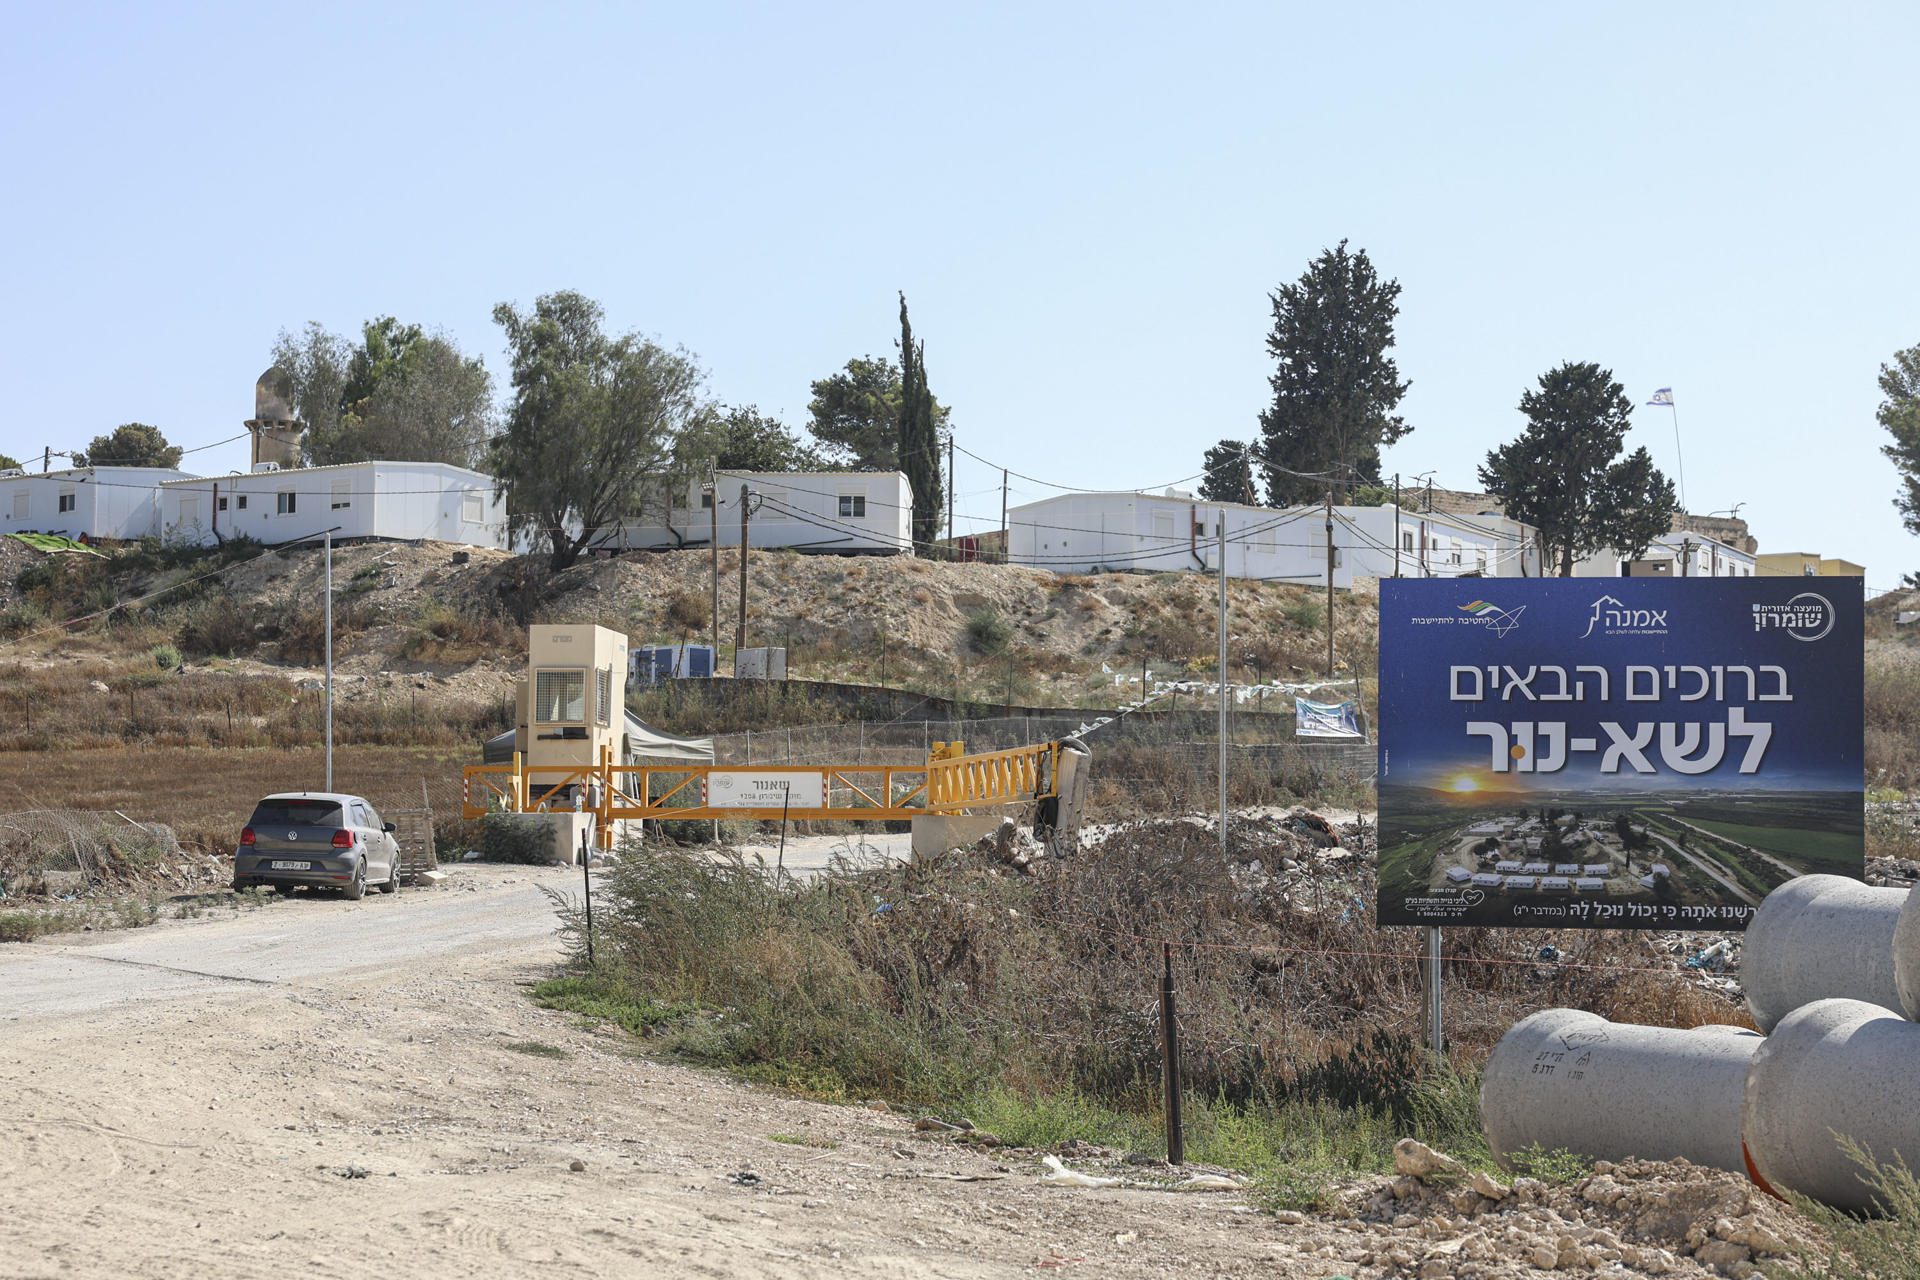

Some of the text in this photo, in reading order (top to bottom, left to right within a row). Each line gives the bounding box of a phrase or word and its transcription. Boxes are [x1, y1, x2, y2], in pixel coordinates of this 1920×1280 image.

[1411, 616, 1455, 625] להתיישבות
[1605, 610, 1667, 627] אמנה
[1752, 612, 1822, 632] שומרון
[1449, 665, 1793, 701] ברוכים הבאים
[752, 780, 791, 791] שאנור
